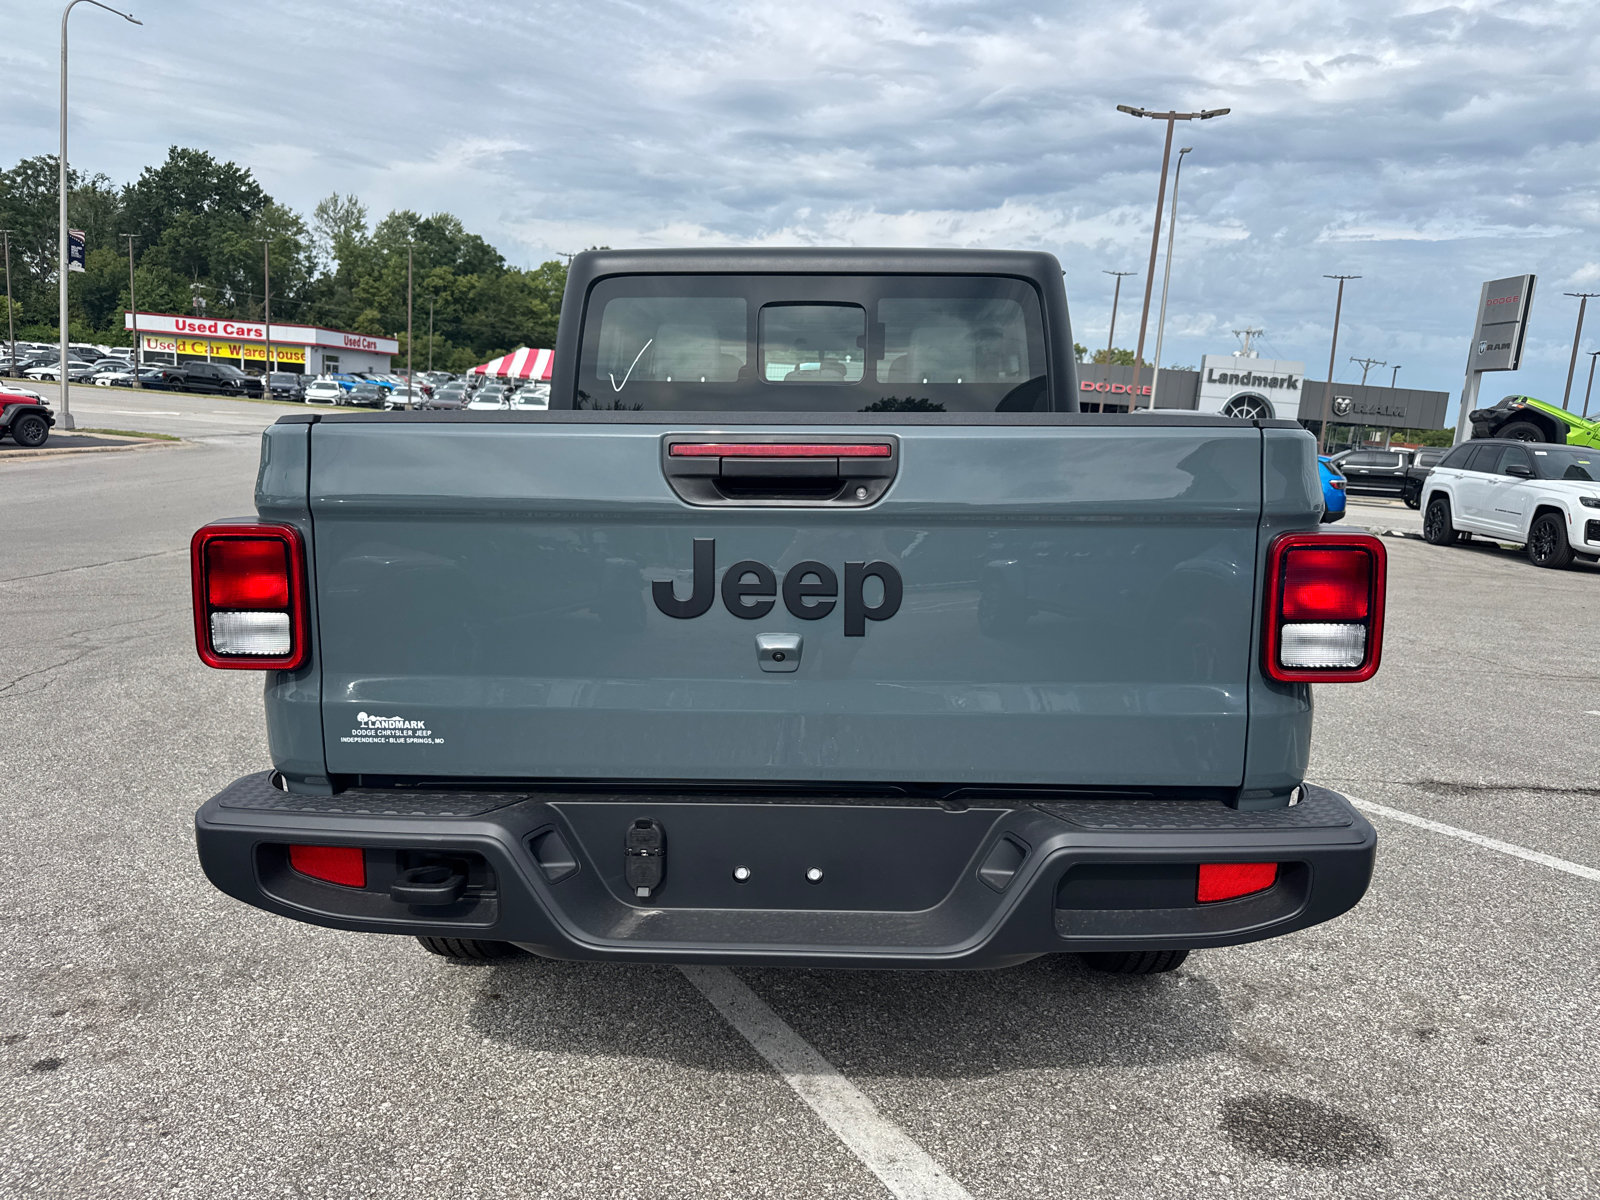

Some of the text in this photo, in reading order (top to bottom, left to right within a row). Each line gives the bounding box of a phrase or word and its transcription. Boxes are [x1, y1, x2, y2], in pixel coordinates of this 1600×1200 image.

[1486, 295, 1520, 306] DODGE
[175, 319, 263, 338] Used Cars
[146, 338, 306, 361] Used Car Warehouse
[344, 334, 377, 350] Used Cars
[1486, 342, 1511, 351] RAM
[1207, 368, 1299, 391] Landmark
[1353, 402, 1407, 418] RAM
[652, 537, 904, 637] Jeep
[368, 720, 425, 729] LANDMARK
